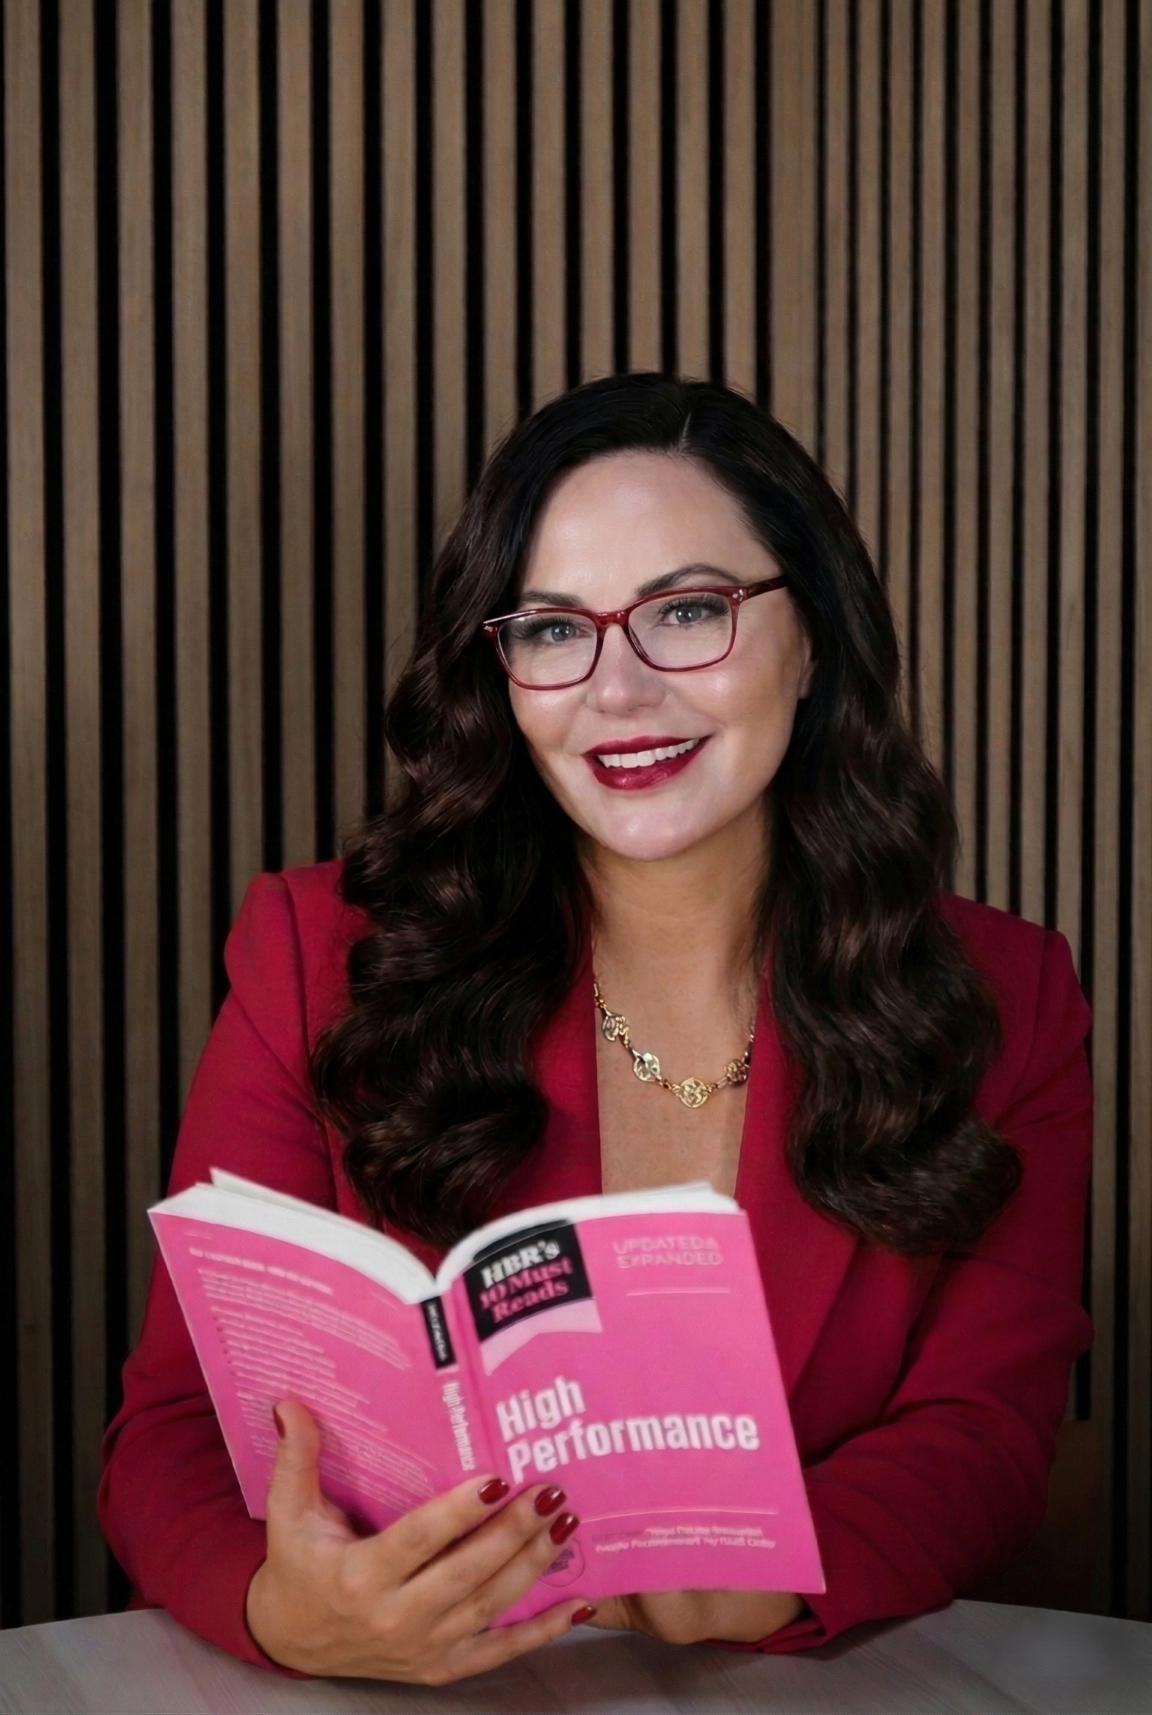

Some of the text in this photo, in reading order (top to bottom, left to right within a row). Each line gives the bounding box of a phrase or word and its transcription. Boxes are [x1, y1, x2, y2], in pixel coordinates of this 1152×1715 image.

[479, 1256, 573, 1309] 10 Must
[480, 1240, 560, 1288] HBR's
[617, 1251, 723, 1269] EXPANDED
[490, 1279, 570, 1323] Reads
[495, 1375, 586, 1442] High
[507, 1413, 761, 1484] Performance
